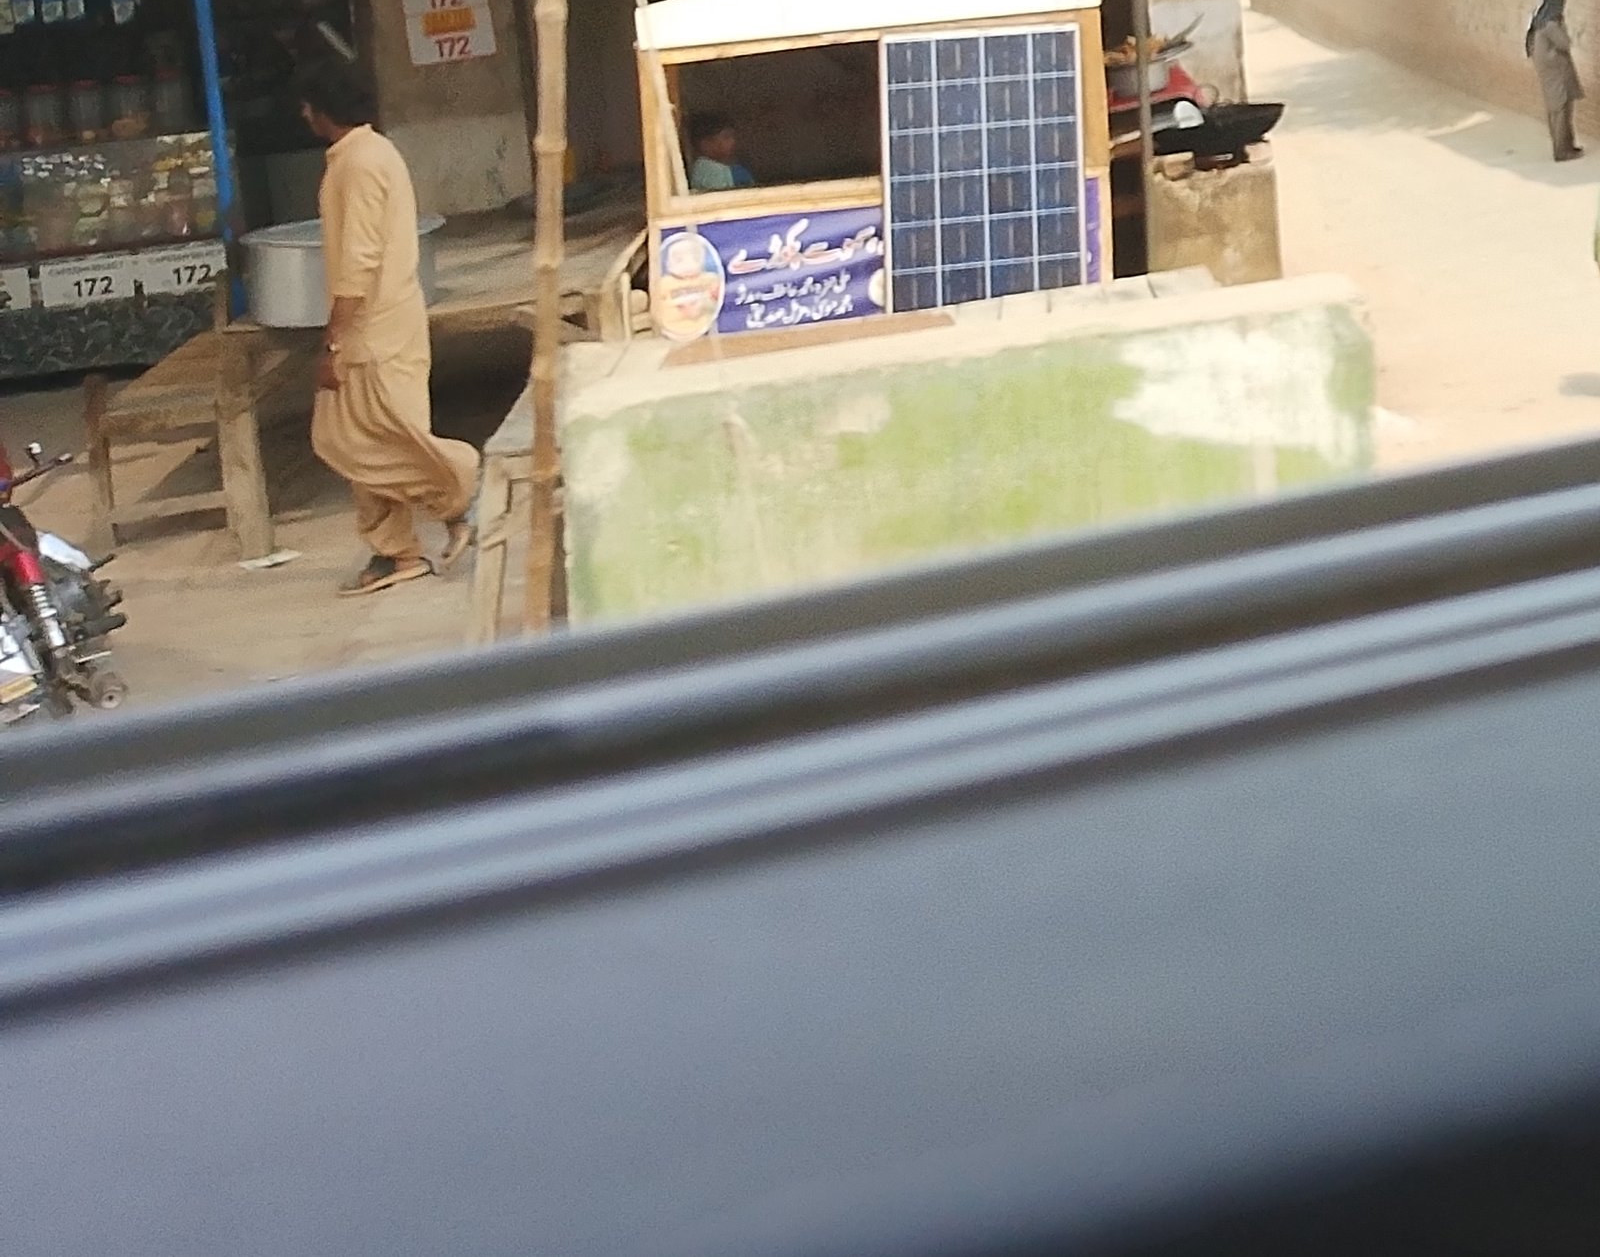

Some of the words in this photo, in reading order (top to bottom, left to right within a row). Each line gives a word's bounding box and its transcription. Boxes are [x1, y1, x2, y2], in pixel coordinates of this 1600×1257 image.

[435, 36, 471, 58] 172
[172, 263, 214, 285] 172
[73, 275, 114, 297] 172
